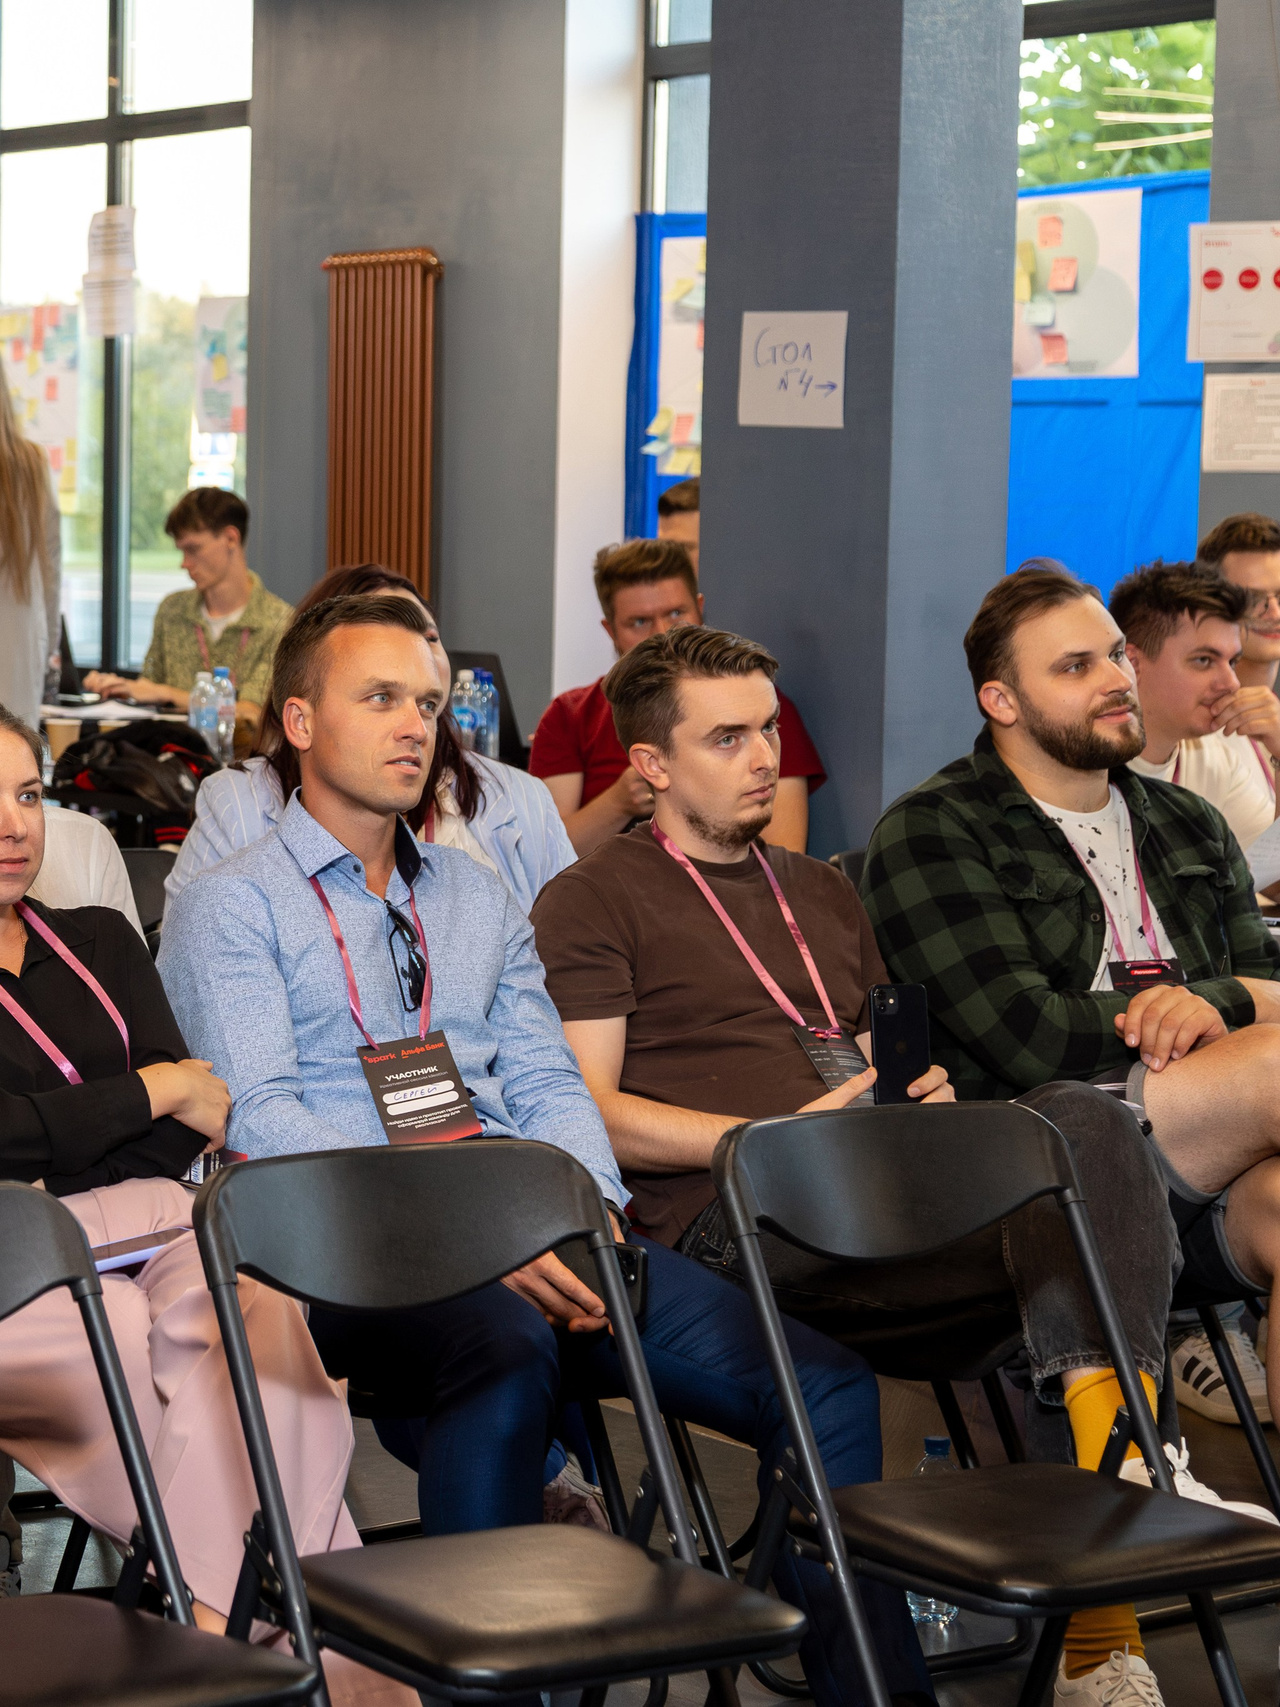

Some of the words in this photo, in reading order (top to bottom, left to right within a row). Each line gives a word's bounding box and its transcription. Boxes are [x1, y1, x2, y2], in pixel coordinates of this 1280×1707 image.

[401, 1046, 426, 1057] Альфа
[425, 1042, 445, 1051] Банк
[384, 1065, 439, 1082] УЧАСТНИК
